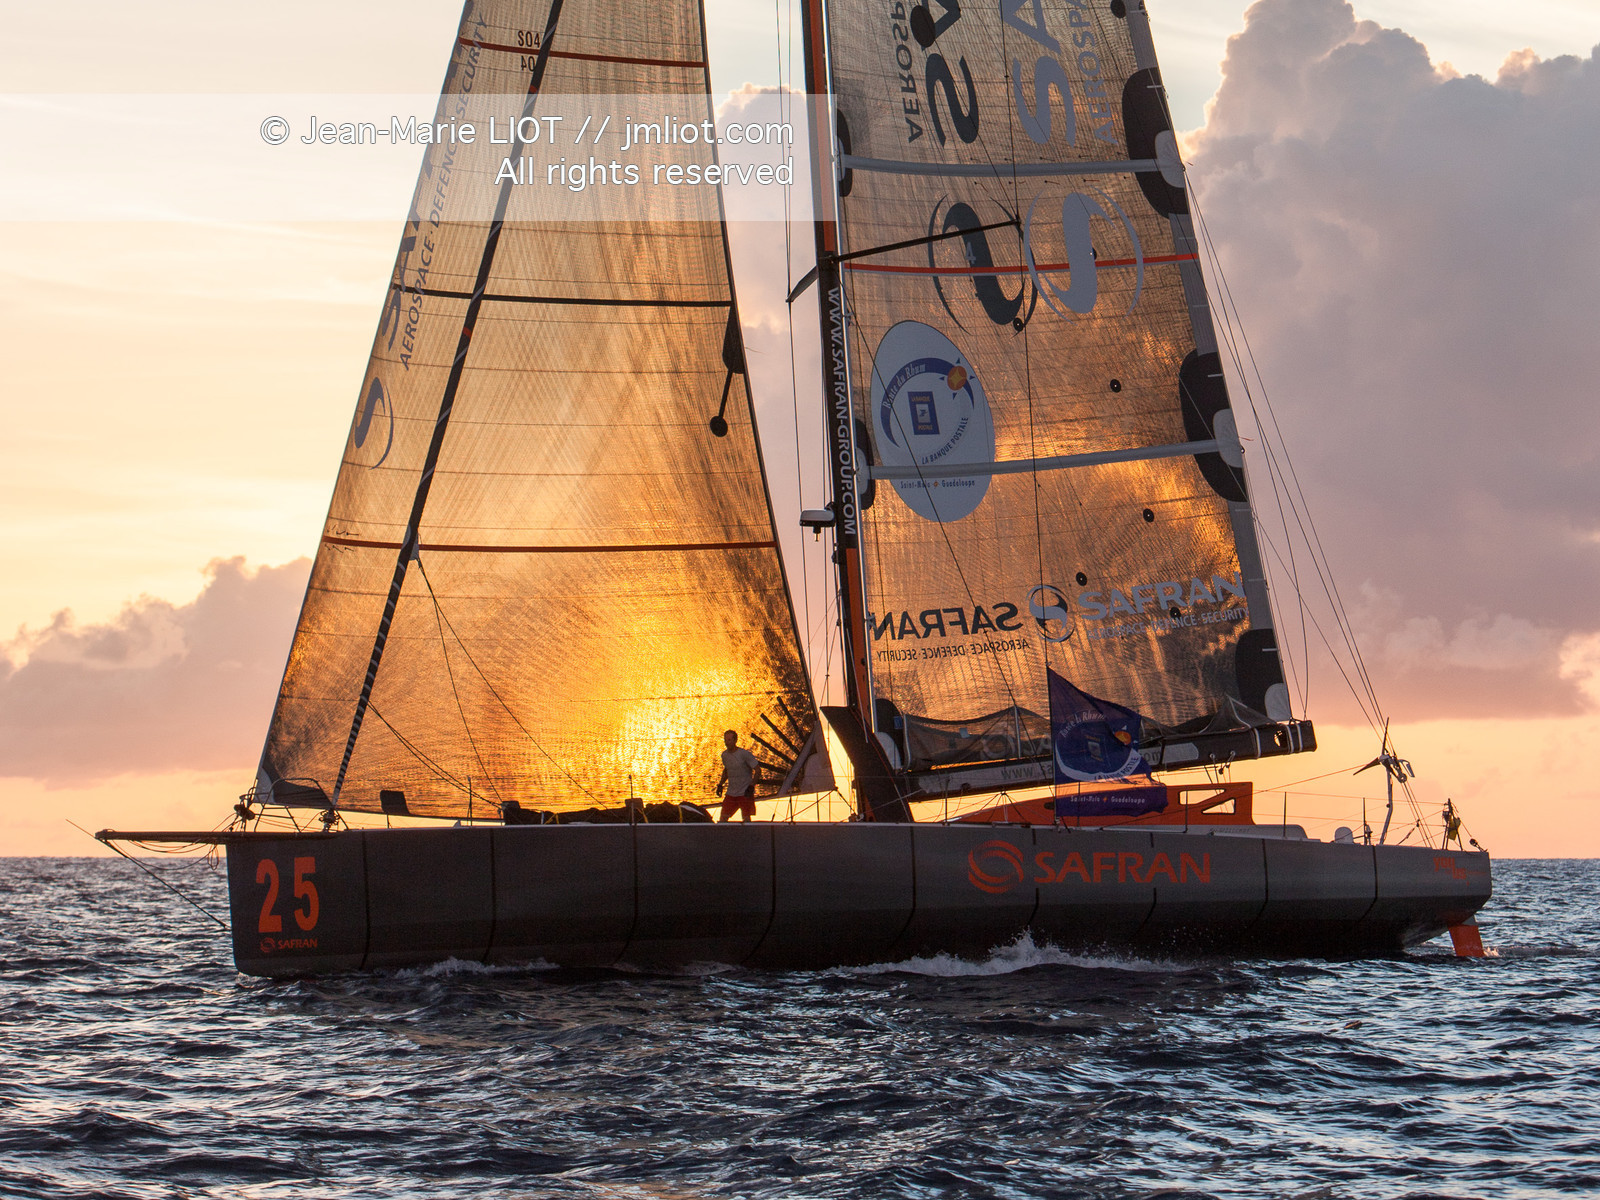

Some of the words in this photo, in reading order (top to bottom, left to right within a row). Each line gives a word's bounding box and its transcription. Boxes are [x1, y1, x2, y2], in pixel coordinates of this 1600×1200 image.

[398, 235, 436, 372] AEROSPACE
[428, 122, 464, 229] DEFENC
[454, 12, 488, 120] SECURITY
[827, 287, 856, 536] WWW.SAFRAN-GROUP.COM
[950, 416, 970, 445] POSTALE
[1077, 570, 1248, 622] SAFRAN
[1201, 606, 1250, 625] SECURITY
[1034, 851, 1211, 884] SAFRAN
[255, 856, 320, 934] 25
[277, 937, 318, 950] SAFRAN
